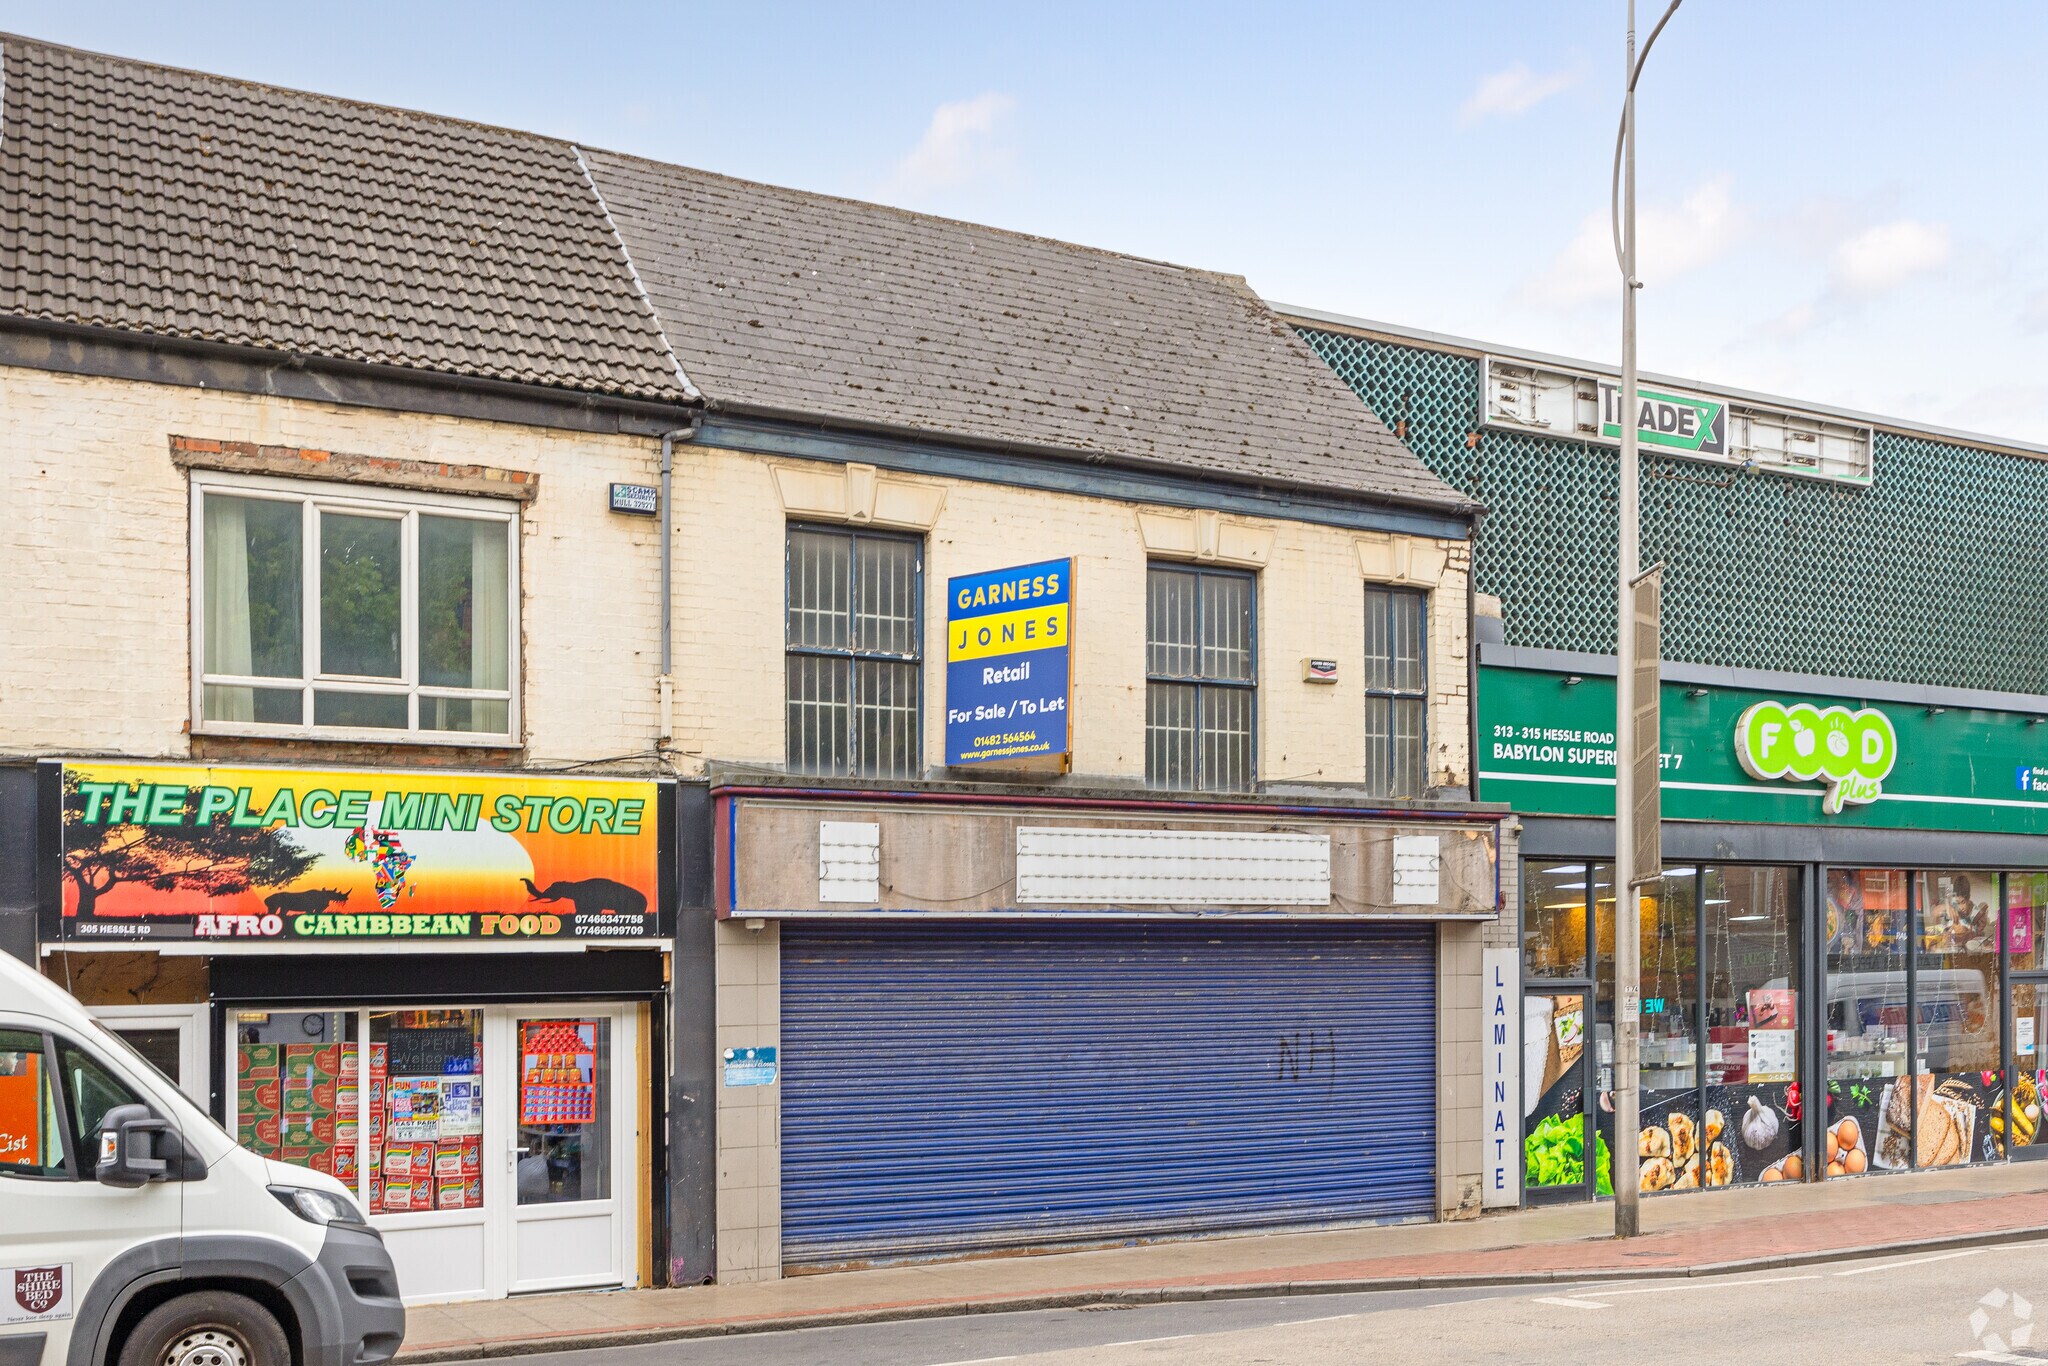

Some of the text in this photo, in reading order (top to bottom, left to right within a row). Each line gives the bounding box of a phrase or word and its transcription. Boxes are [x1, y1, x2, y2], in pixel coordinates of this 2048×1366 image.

[1599, 383, 1718, 443] TADEX
[957, 573, 1060, 610] GARNESS
[958, 616, 1058, 650] JONES
[983, 661, 1030, 686] Retail
[948, 708, 972, 725] For
[974, 702, 1006, 721] Sale
[1019, 698, 1037, 715] To
[1039, 696, 1065, 713] Let
[974, 730, 1037, 748] 01482 564564
[1493, 725, 1514, 738] 313
[1522, 727, 1541, 740] 315
[1543, 729, 1582, 743] HESSLE
[1583, 732, 1615, 745] ROAD
[960, 741, 1050, 761] www.garnessjones.co.uk
[1493, 742, 1565, 763] BABYLON
[1674, 754, 1683, 770] 7
[1835, 776, 1878, 809] plus
[2032, 778, 2048, 791] fac
[78, 781, 645, 835] THE PLACE MINI STORE
[194, 914, 562, 936] AFRO CARIBBEAN FOOD
[574, 914, 644, 924] 07466347758
[80, 924, 151, 934] 305 HESSLE RD
[574, 926, 644, 935] 07466999709
[408, 1038, 456, 1051] OPEN
[399, 1052, 464, 1064] Welcome
[395, 1081, 411, 1090] FUN
[420, 1080, 438, 1090] FAIR
[1494, 965, 1506, 1190] LAMINATE
[16, 1279, 61, 1293] SHIRE
[23, 1271, 54, 1283] THE
[25, 1289, 54, 1302] BED
